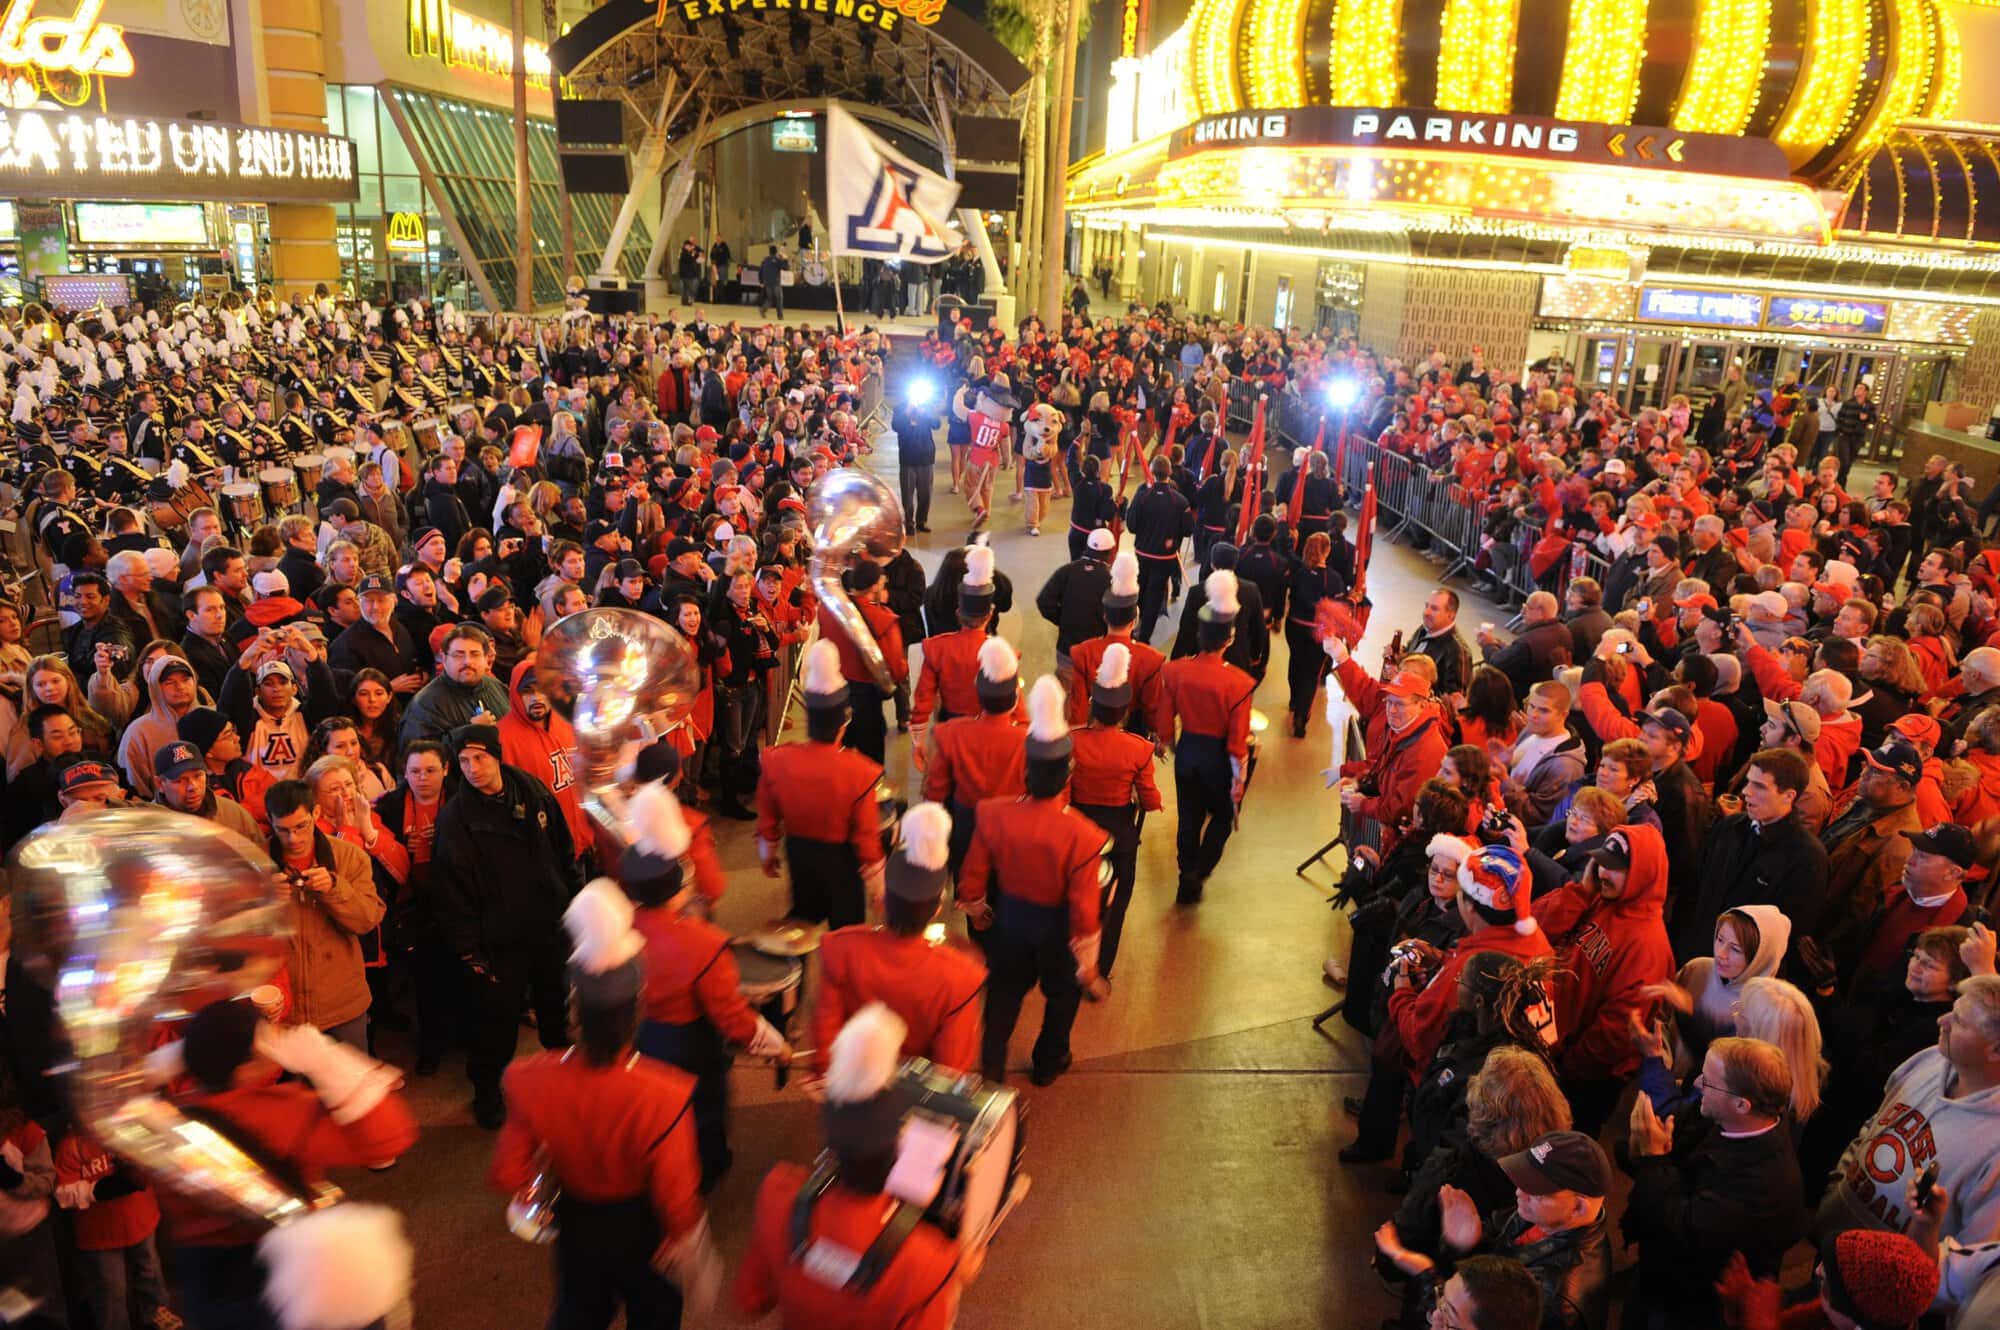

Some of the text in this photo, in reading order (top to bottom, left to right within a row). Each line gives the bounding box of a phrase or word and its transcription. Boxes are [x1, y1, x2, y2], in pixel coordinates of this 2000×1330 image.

[0, 111, 162, 175] ATED
[1194, 113, 1286, 142] ARKING
[1352, 113, 1579, 152] PARKING
[1788, 302, 1865, 326] $2,500
[976, 424, 1000, 448] 08
[262, 733, 297, 766] A
